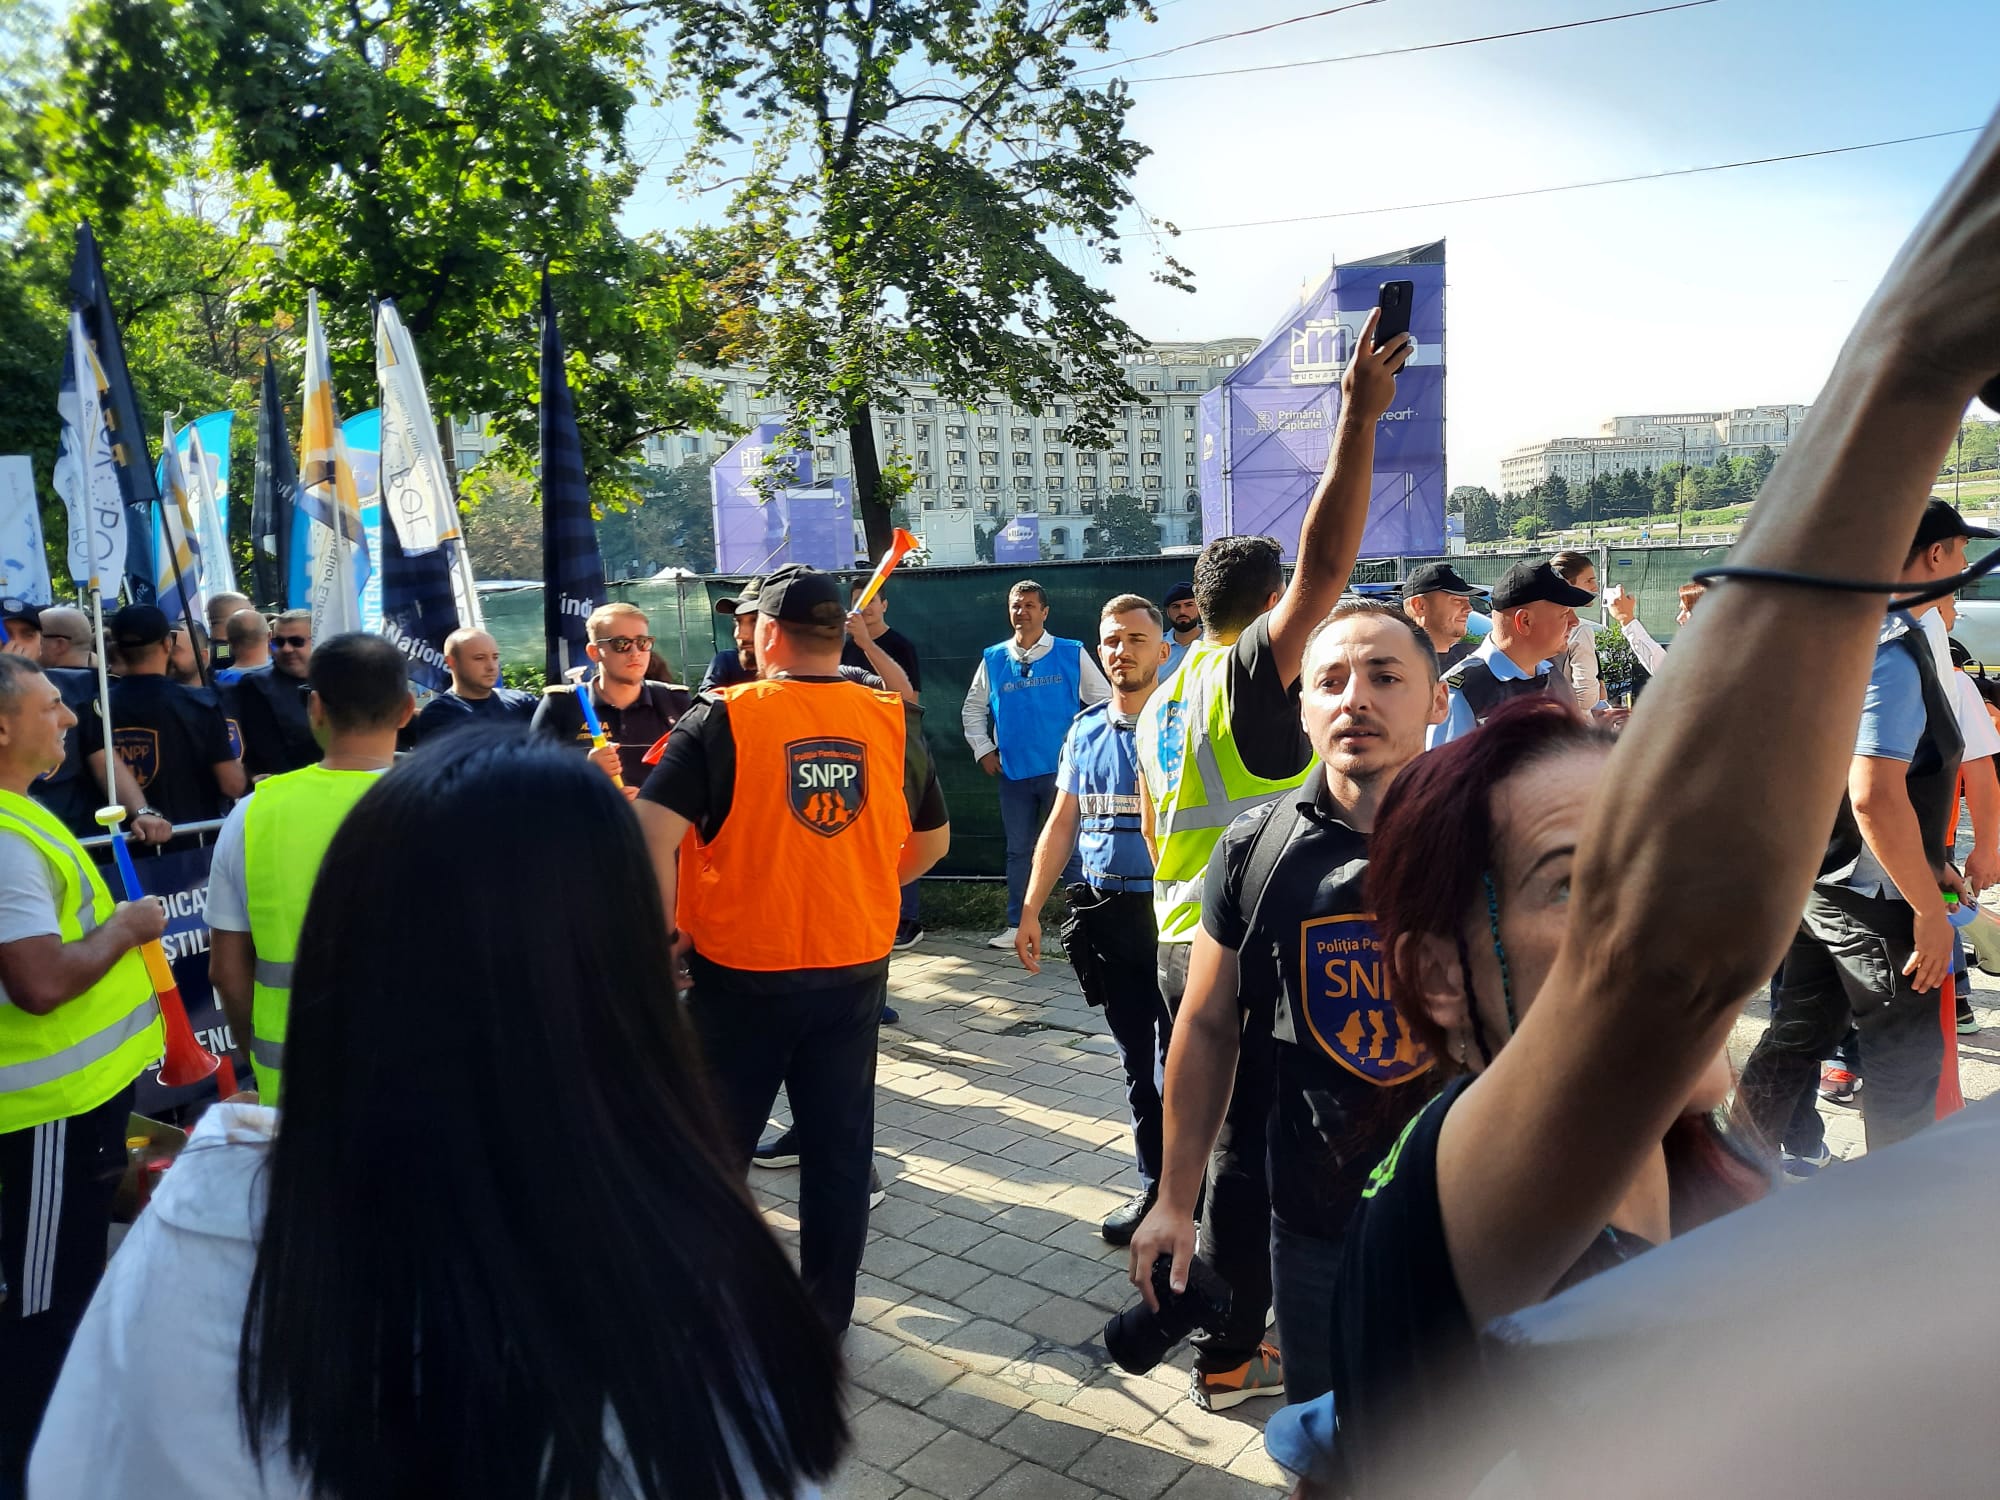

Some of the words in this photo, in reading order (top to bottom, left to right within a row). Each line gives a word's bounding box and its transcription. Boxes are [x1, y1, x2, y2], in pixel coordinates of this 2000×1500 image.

[798, 763, 858, 788] SNPP
[160, 928, 212, 966] ȘTIL
[1316, 937, 1360, 955] Poliția
